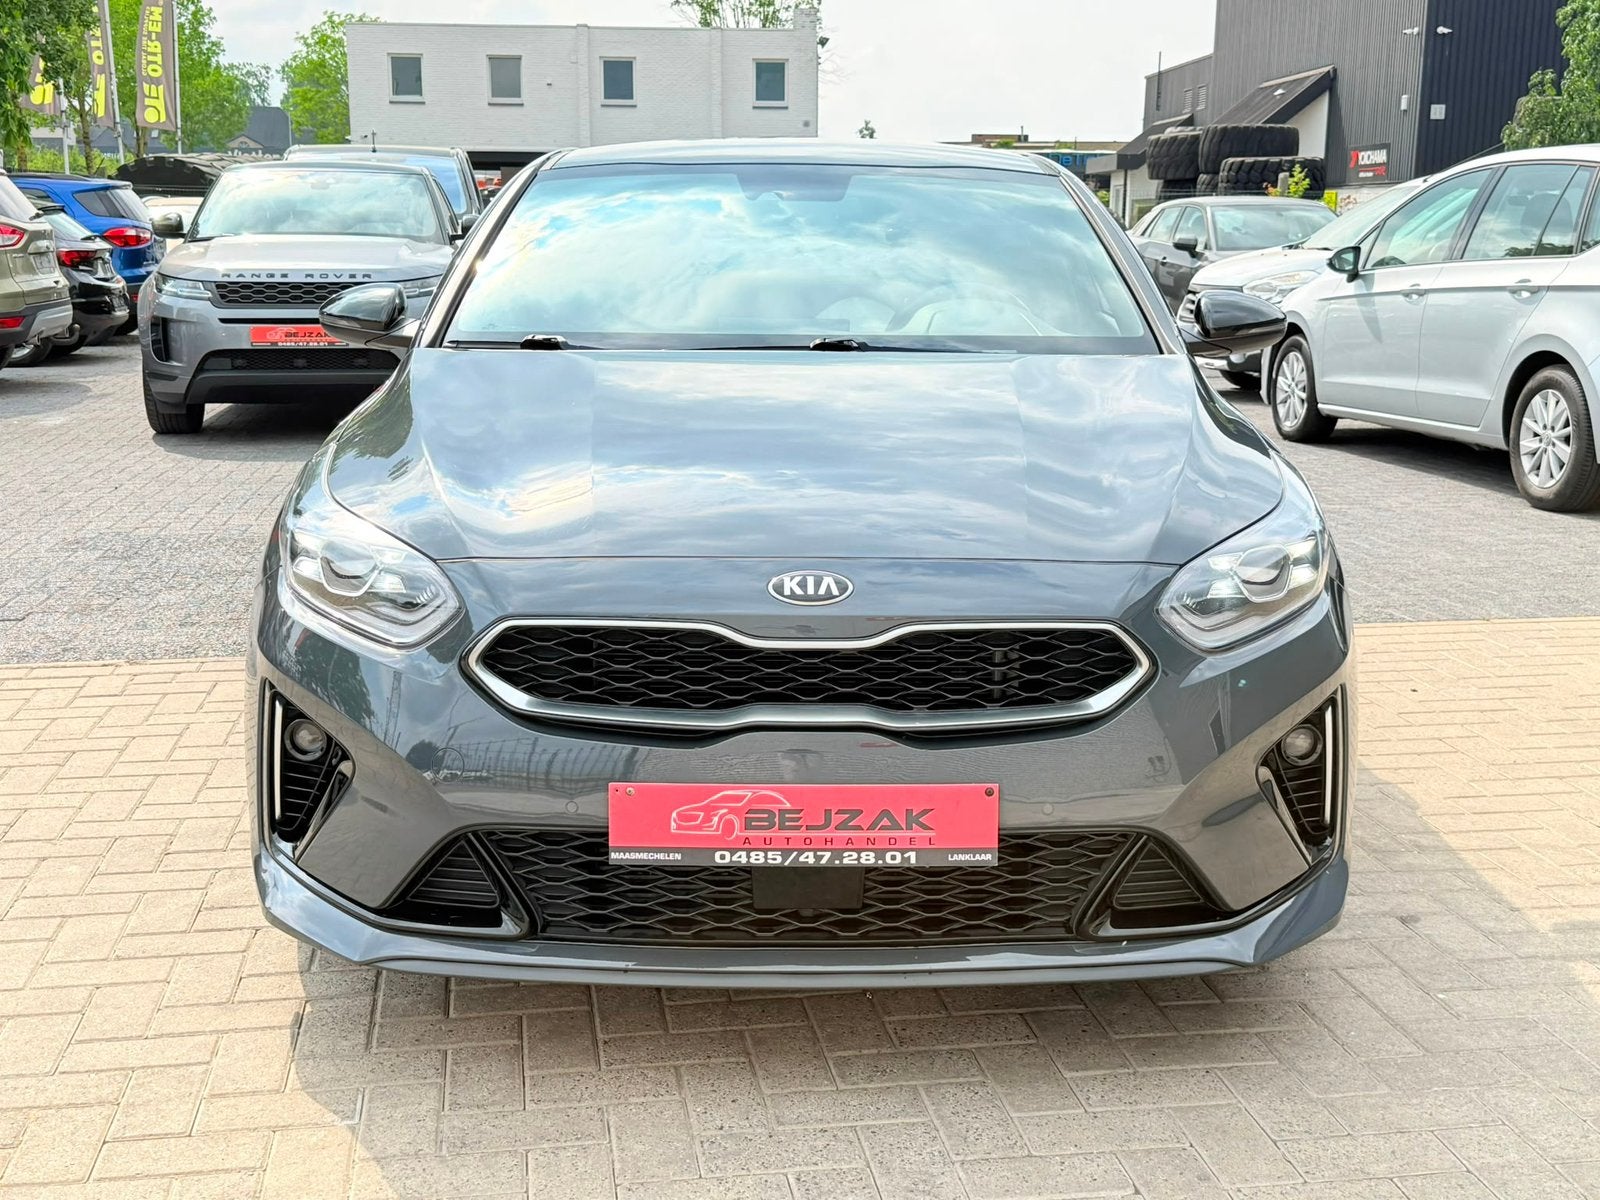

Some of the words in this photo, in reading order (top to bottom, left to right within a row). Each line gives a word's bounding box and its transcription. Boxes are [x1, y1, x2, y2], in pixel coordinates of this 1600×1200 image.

[782, 575, 840, 596] KIA
[744, 808, 935, 831] BEJZAK
[742, 836, 936, 846] AUTOHANDEL
[610, 851, 682, 861] MAASMECHELEN
[714, 850, 917, 866] 0485/47.28.01
[948, 853, 992, 862] LANKLAAR
